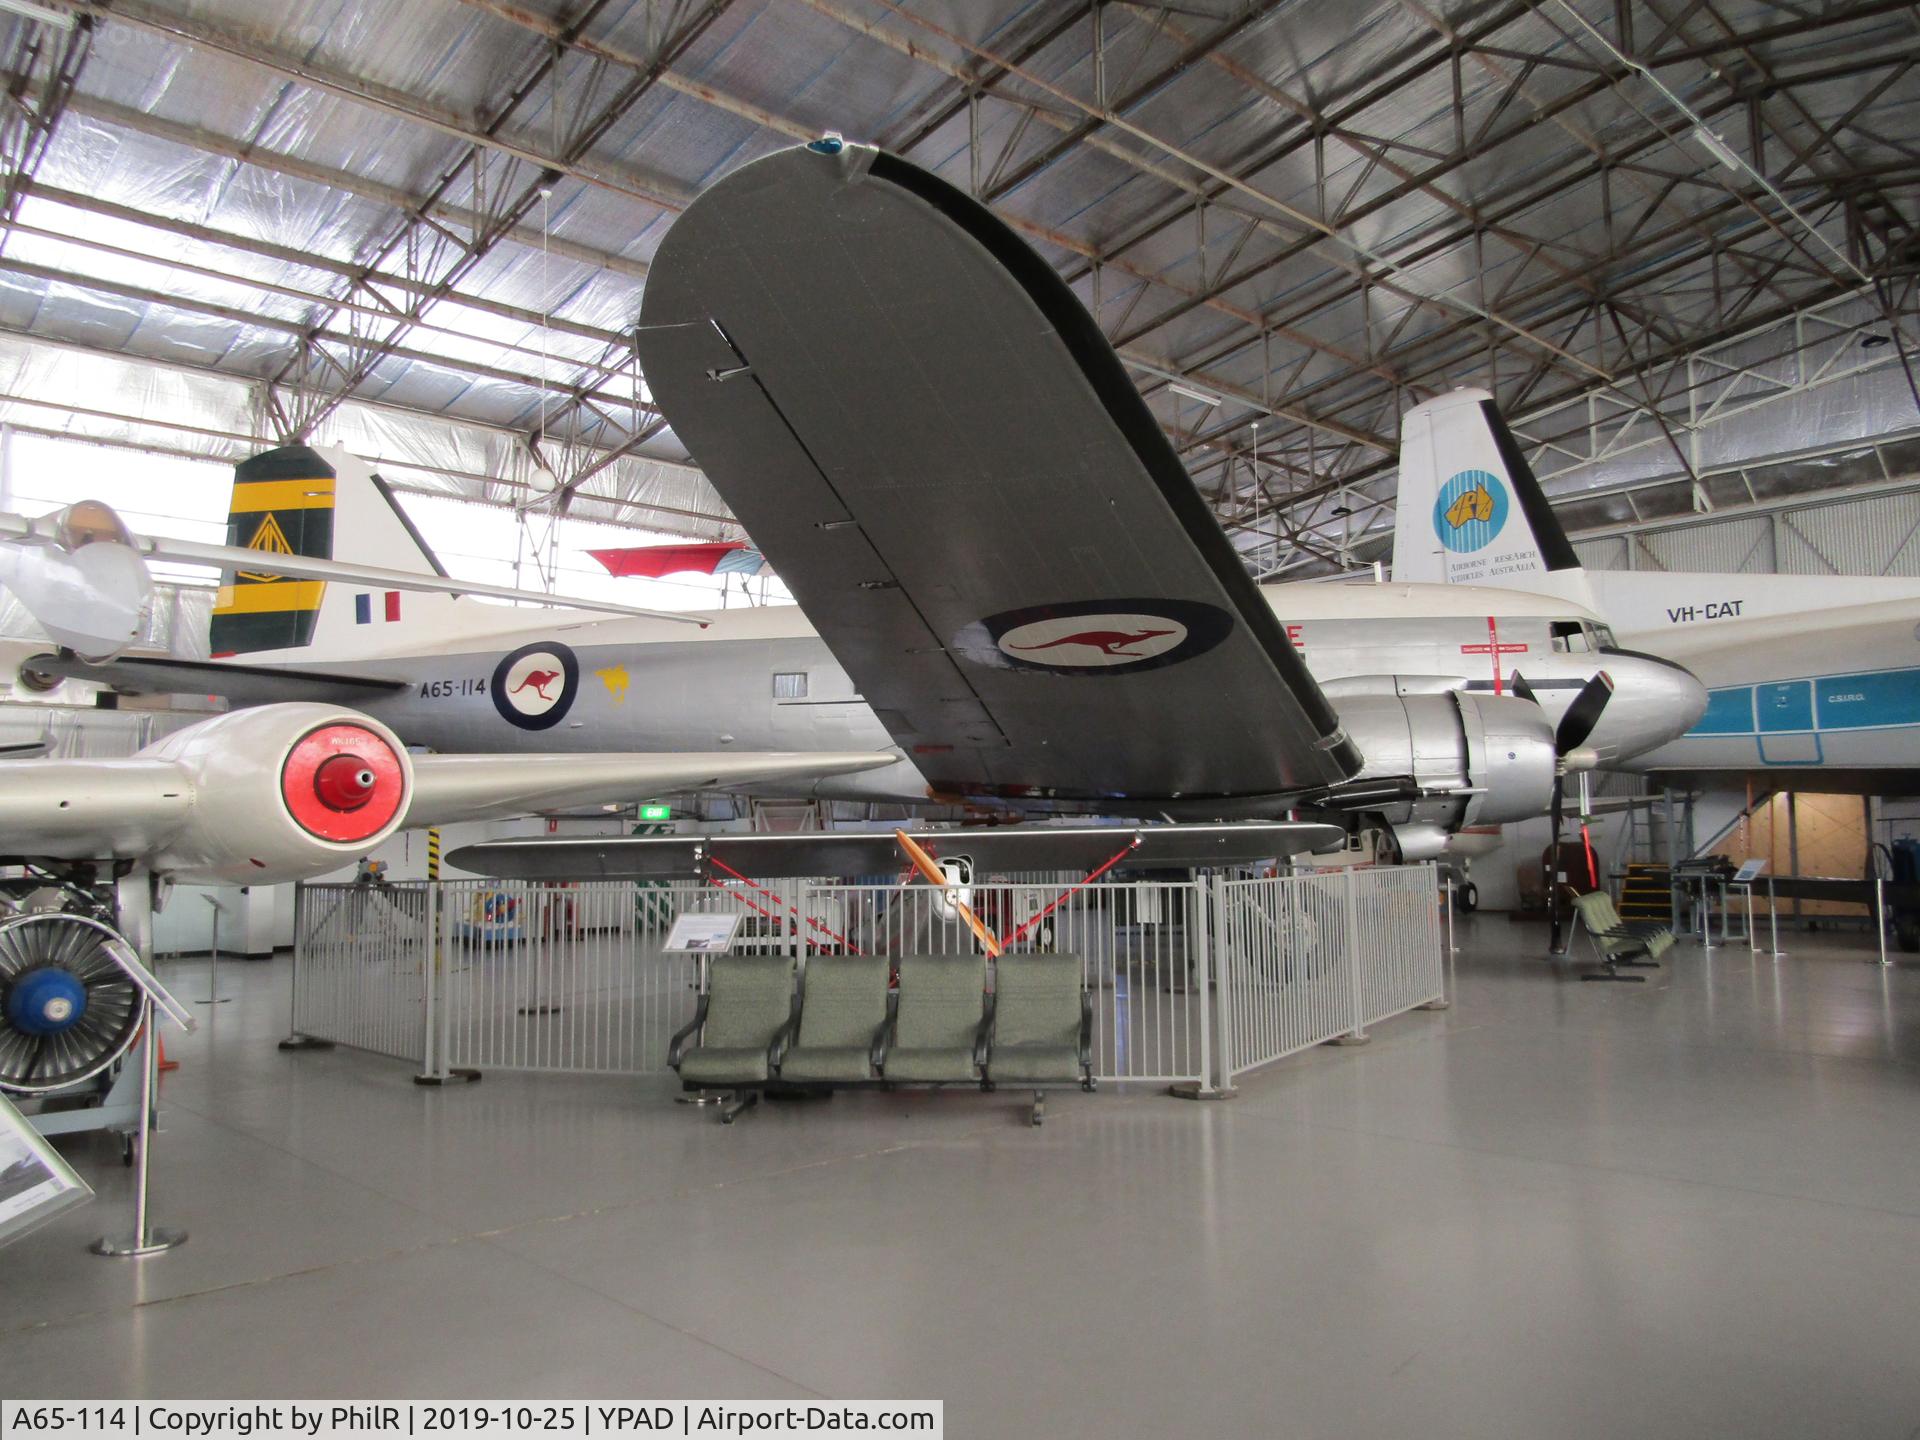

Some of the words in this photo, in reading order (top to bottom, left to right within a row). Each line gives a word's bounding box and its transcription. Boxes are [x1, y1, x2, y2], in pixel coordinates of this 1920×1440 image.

[1450, 559, 1486, 572] AIRBORNE
[1494, 551, 1536, 562] RESEARCH
[1450, 571, 1484, 584] VEHICLES
[1489, 562, 1536, 576] AUSTRALIA
[1667, 600, 1743, 623] VH-CAT
[420, 678, 486, 698] A65-114
